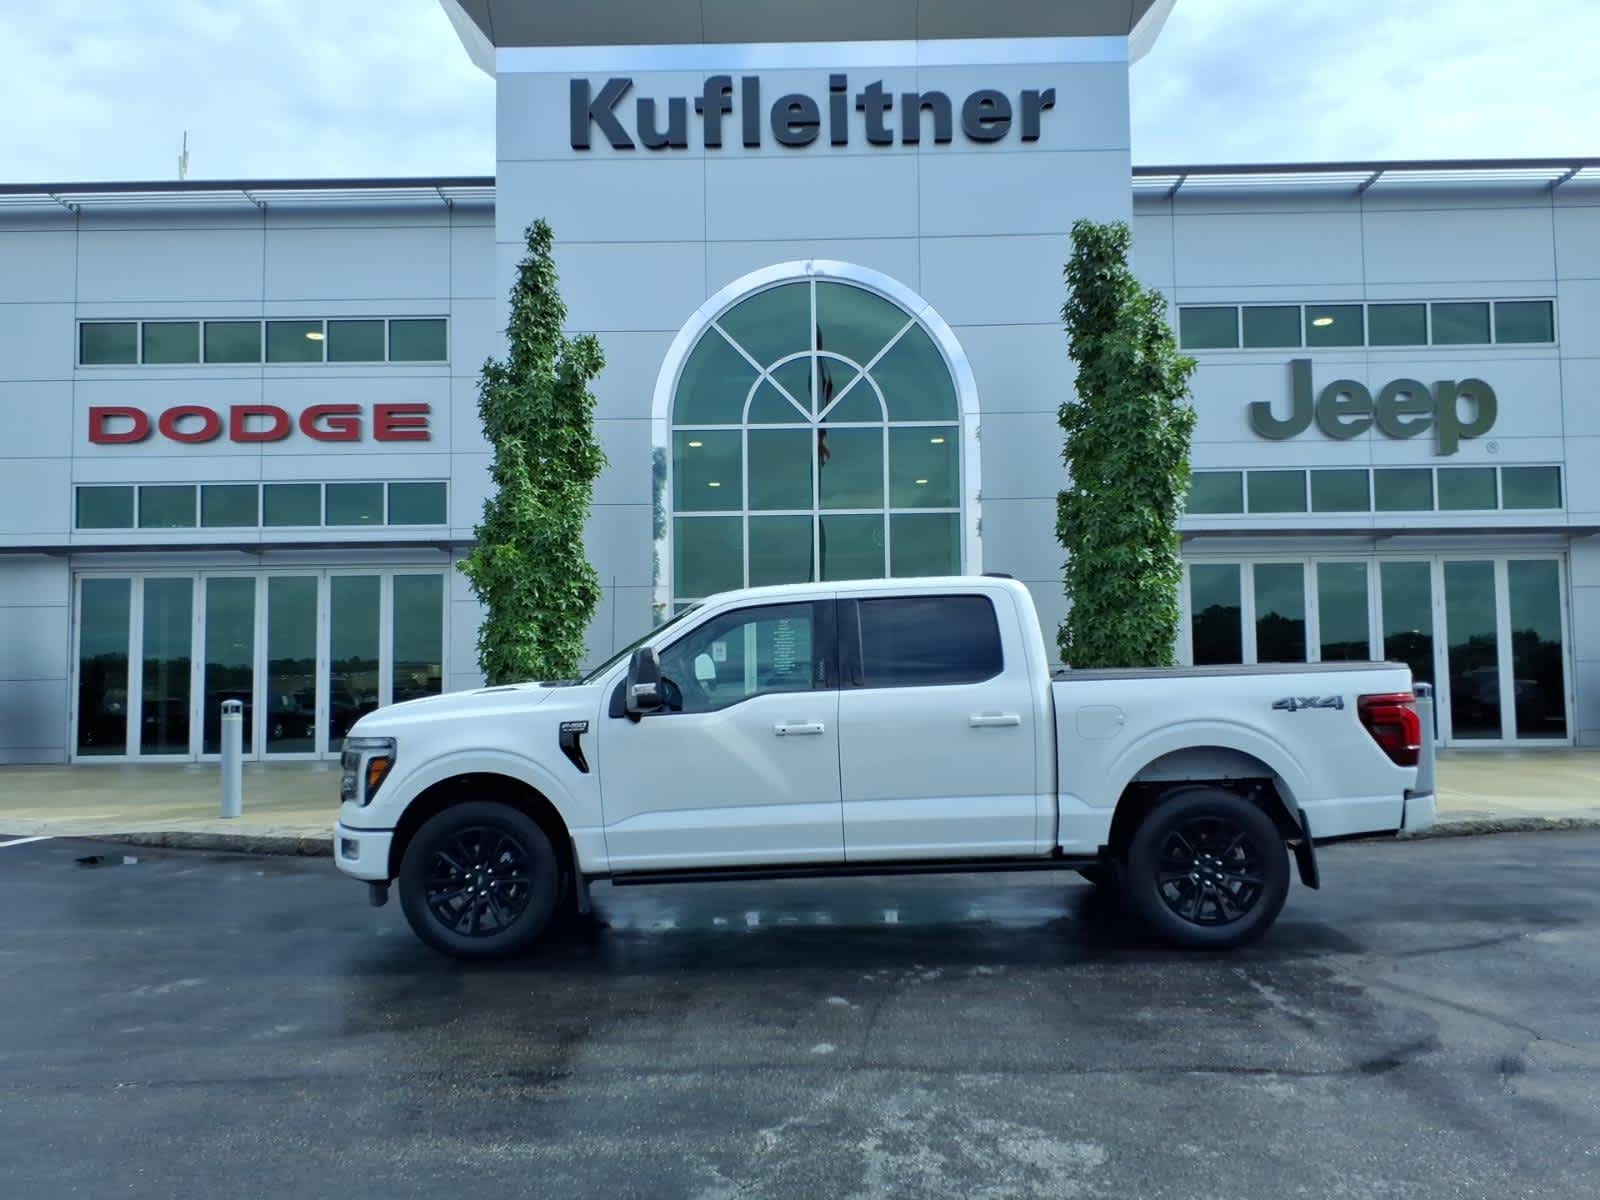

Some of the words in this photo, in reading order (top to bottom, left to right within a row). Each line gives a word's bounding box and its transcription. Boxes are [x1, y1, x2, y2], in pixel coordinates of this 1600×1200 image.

[570, 74, 1056, 150] Kufleitner
[88, 403, 431, 445] DODGE
[1249, 358, 1498, 456] Jeep
